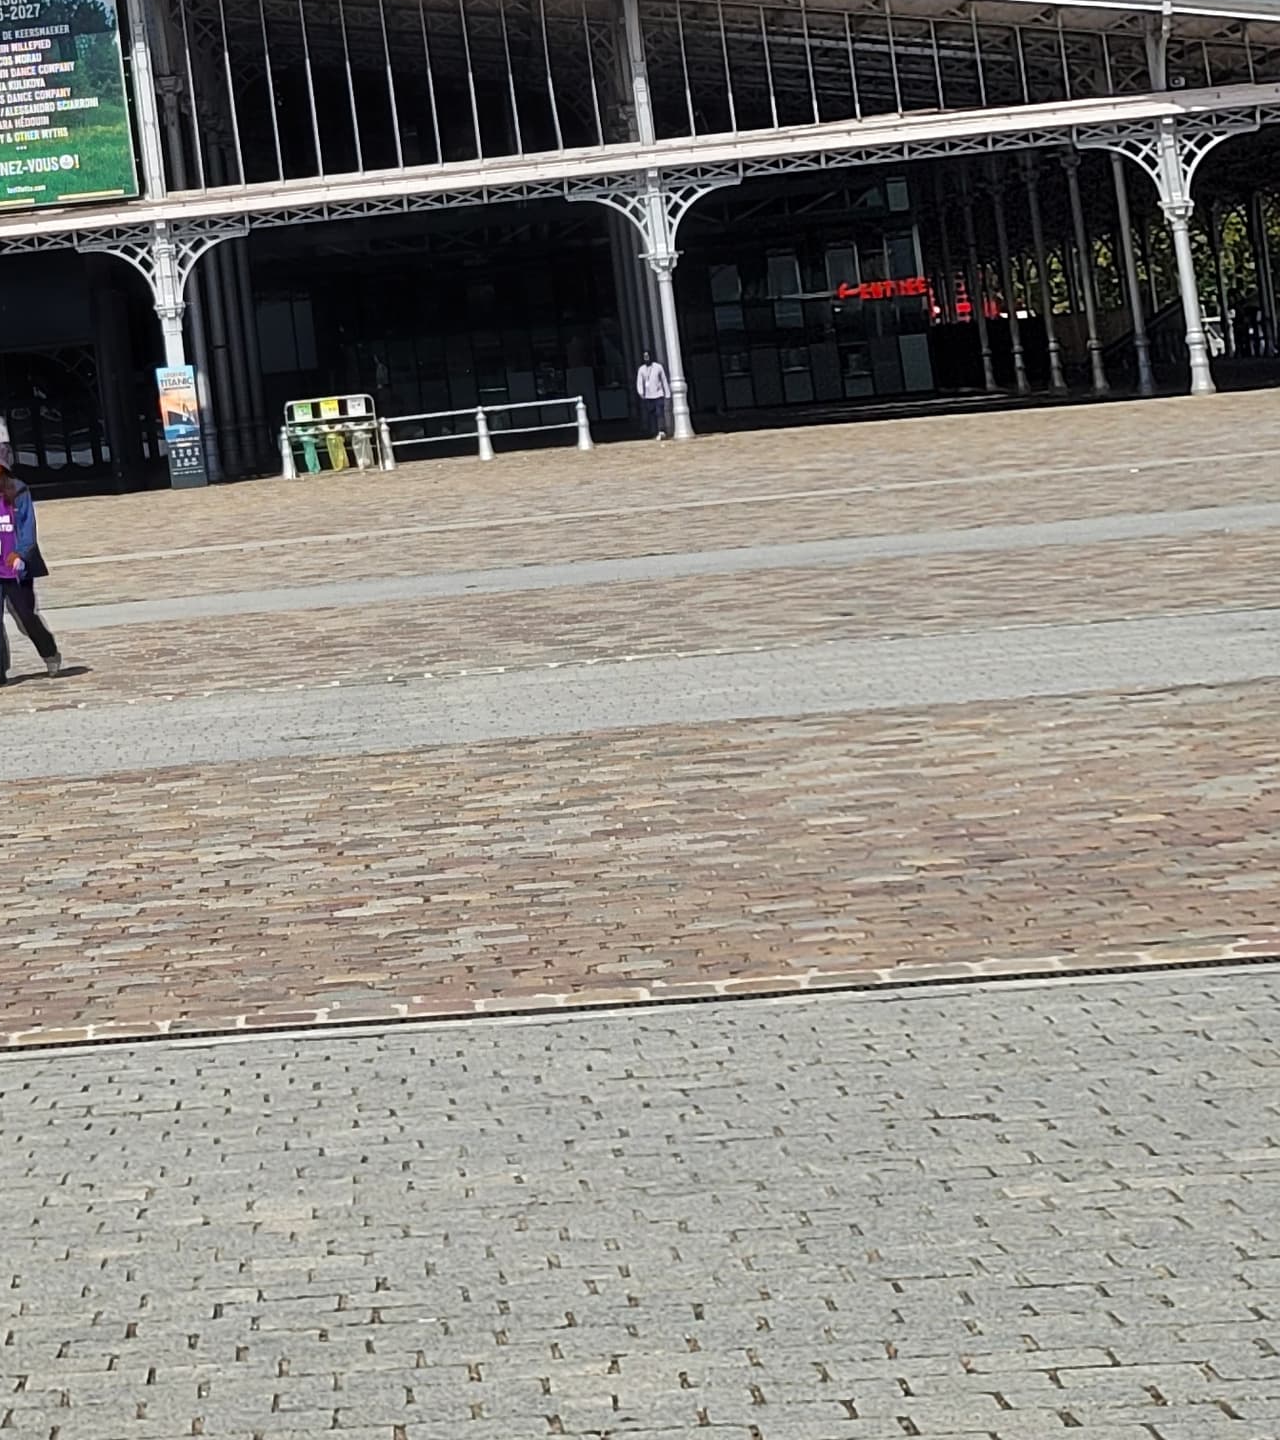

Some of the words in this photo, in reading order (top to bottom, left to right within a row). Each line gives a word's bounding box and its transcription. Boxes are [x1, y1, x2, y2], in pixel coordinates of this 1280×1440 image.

[2, 30, 13, 41] DE
[15, 24, 70, 39] KEERSMAEKER
[10, 65, 36, 78] DANCE
[38, 61, 75, 75] COMPANY
[7, 91, 33, 104] DANCE
[35, 87, 71, 100] COMPANY
[6, 133, 13, 143] &
[14, 130, 40, 142] OTHER
[41, 127, 69, 139] MYTHS
